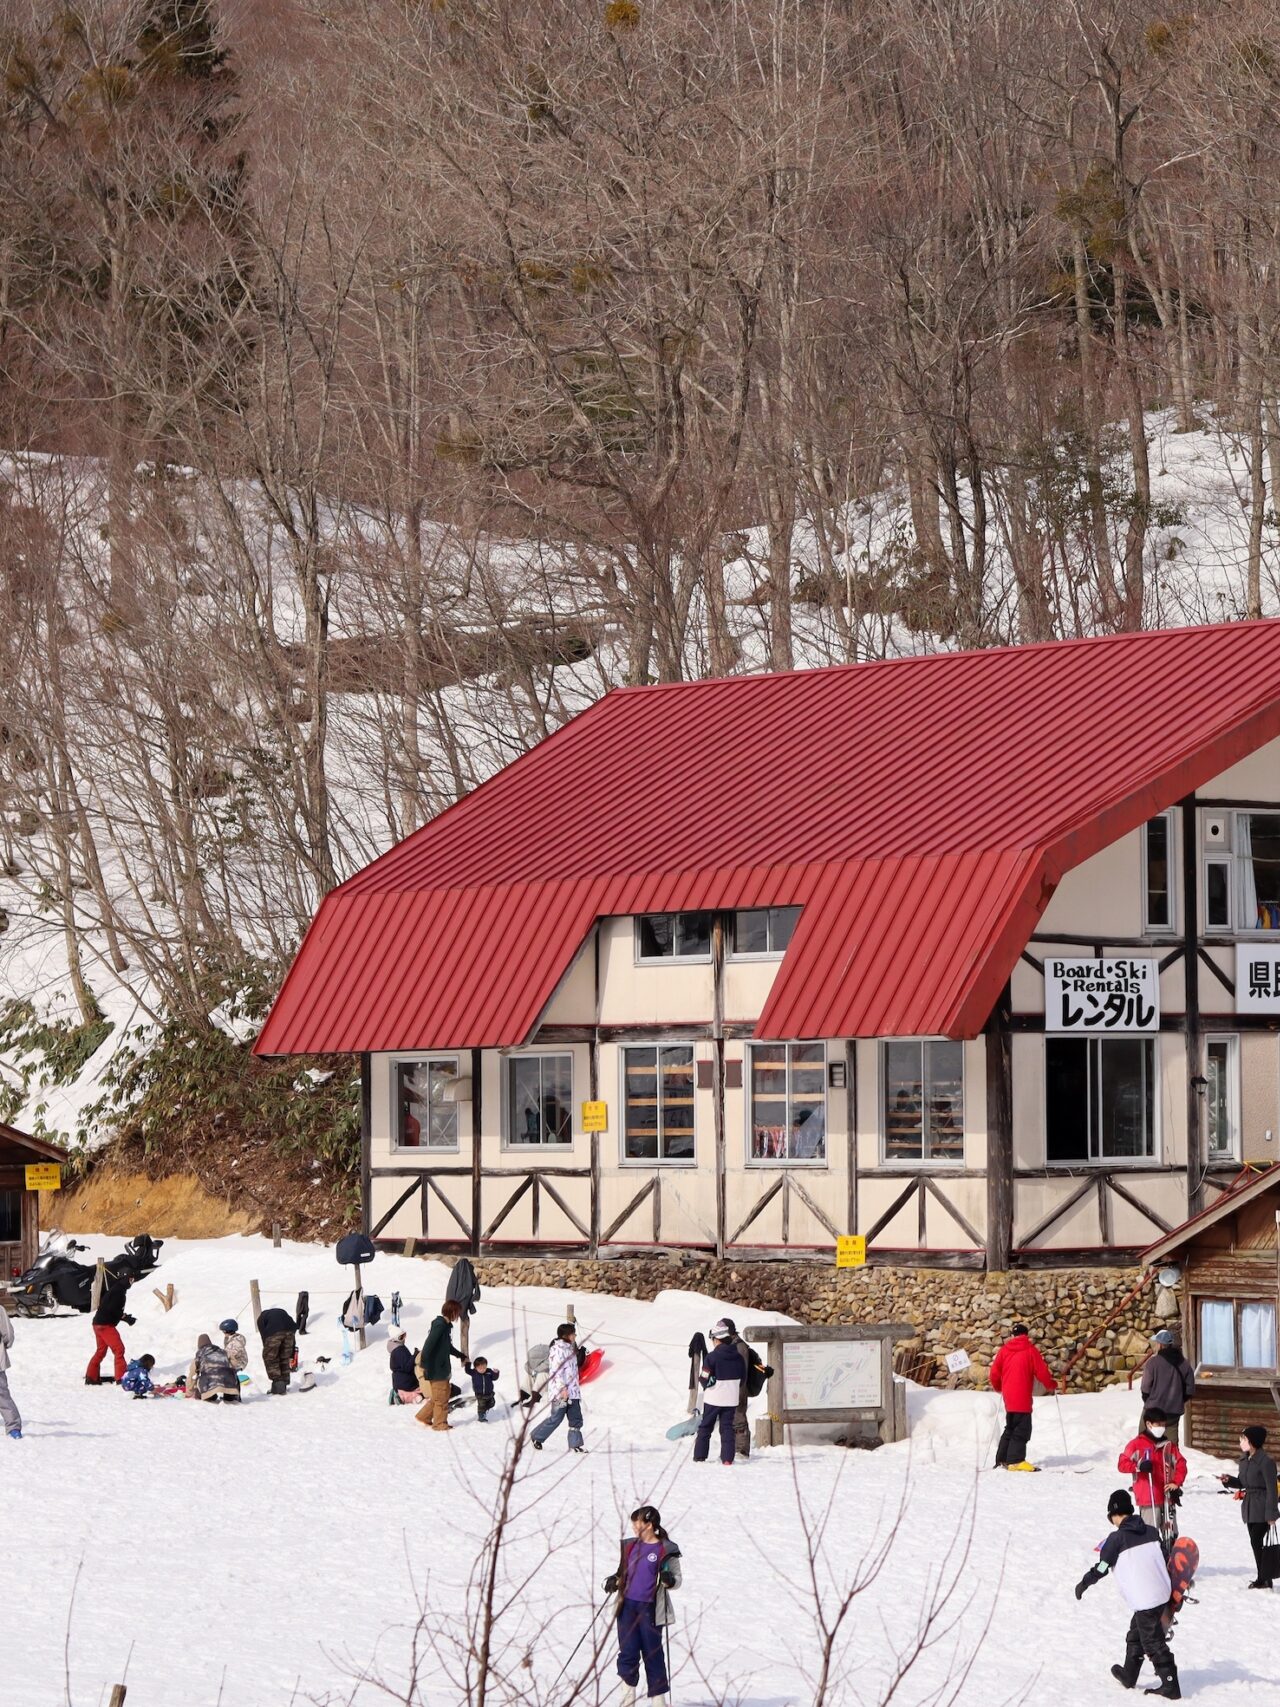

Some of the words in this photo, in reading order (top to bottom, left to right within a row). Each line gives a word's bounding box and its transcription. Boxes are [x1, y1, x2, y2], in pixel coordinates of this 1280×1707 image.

[1073, 978, 1141, 994] Rentals
[1062, 993, 1155, 1028] レンタル
